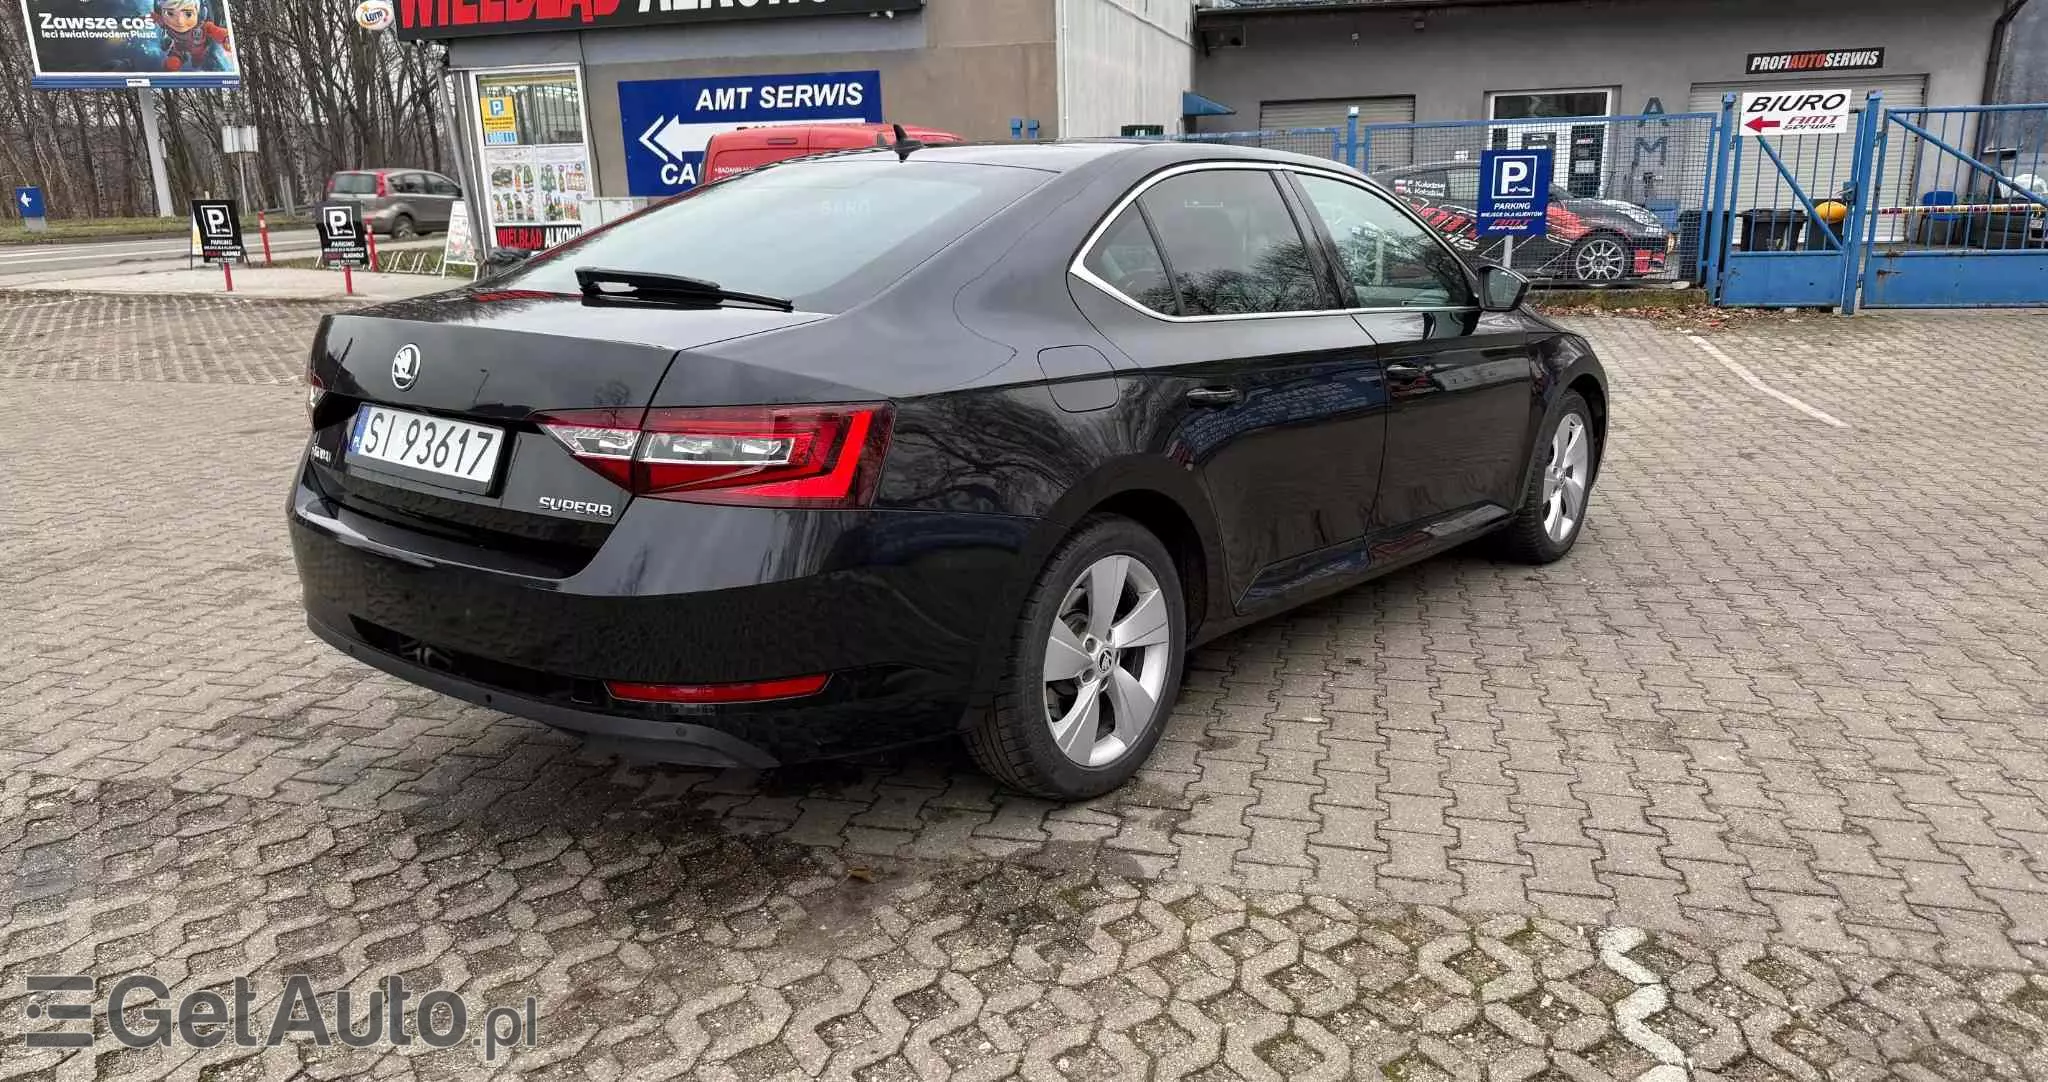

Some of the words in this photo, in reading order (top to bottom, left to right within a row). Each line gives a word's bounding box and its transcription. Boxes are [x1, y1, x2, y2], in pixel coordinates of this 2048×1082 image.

[38, 12, 118, 29] Zawsze
[121, 13, 156, 30] coś
[41, 30, 58, 39] leci
[60, 30, 130, 39] światłowodem
[130, 30, 157, 39] Plusa
[1751, 51, 1880, 70] PROFIAUTOSERWIS
[695, 86, 753, 111] AMT
[759, 82, 864, 109] SERWIS
[1746, 93, 1847, 113] BIURO
[1787, 115, 1842, 124] AMT
[660, 162, 702, 185] CA
[1493, 202, 1531, 210] PARKING
[365, 412, 396, 457] SI
[400, 418, 494, 476] 93617
[539, 496, 612, 517] SUPERB
